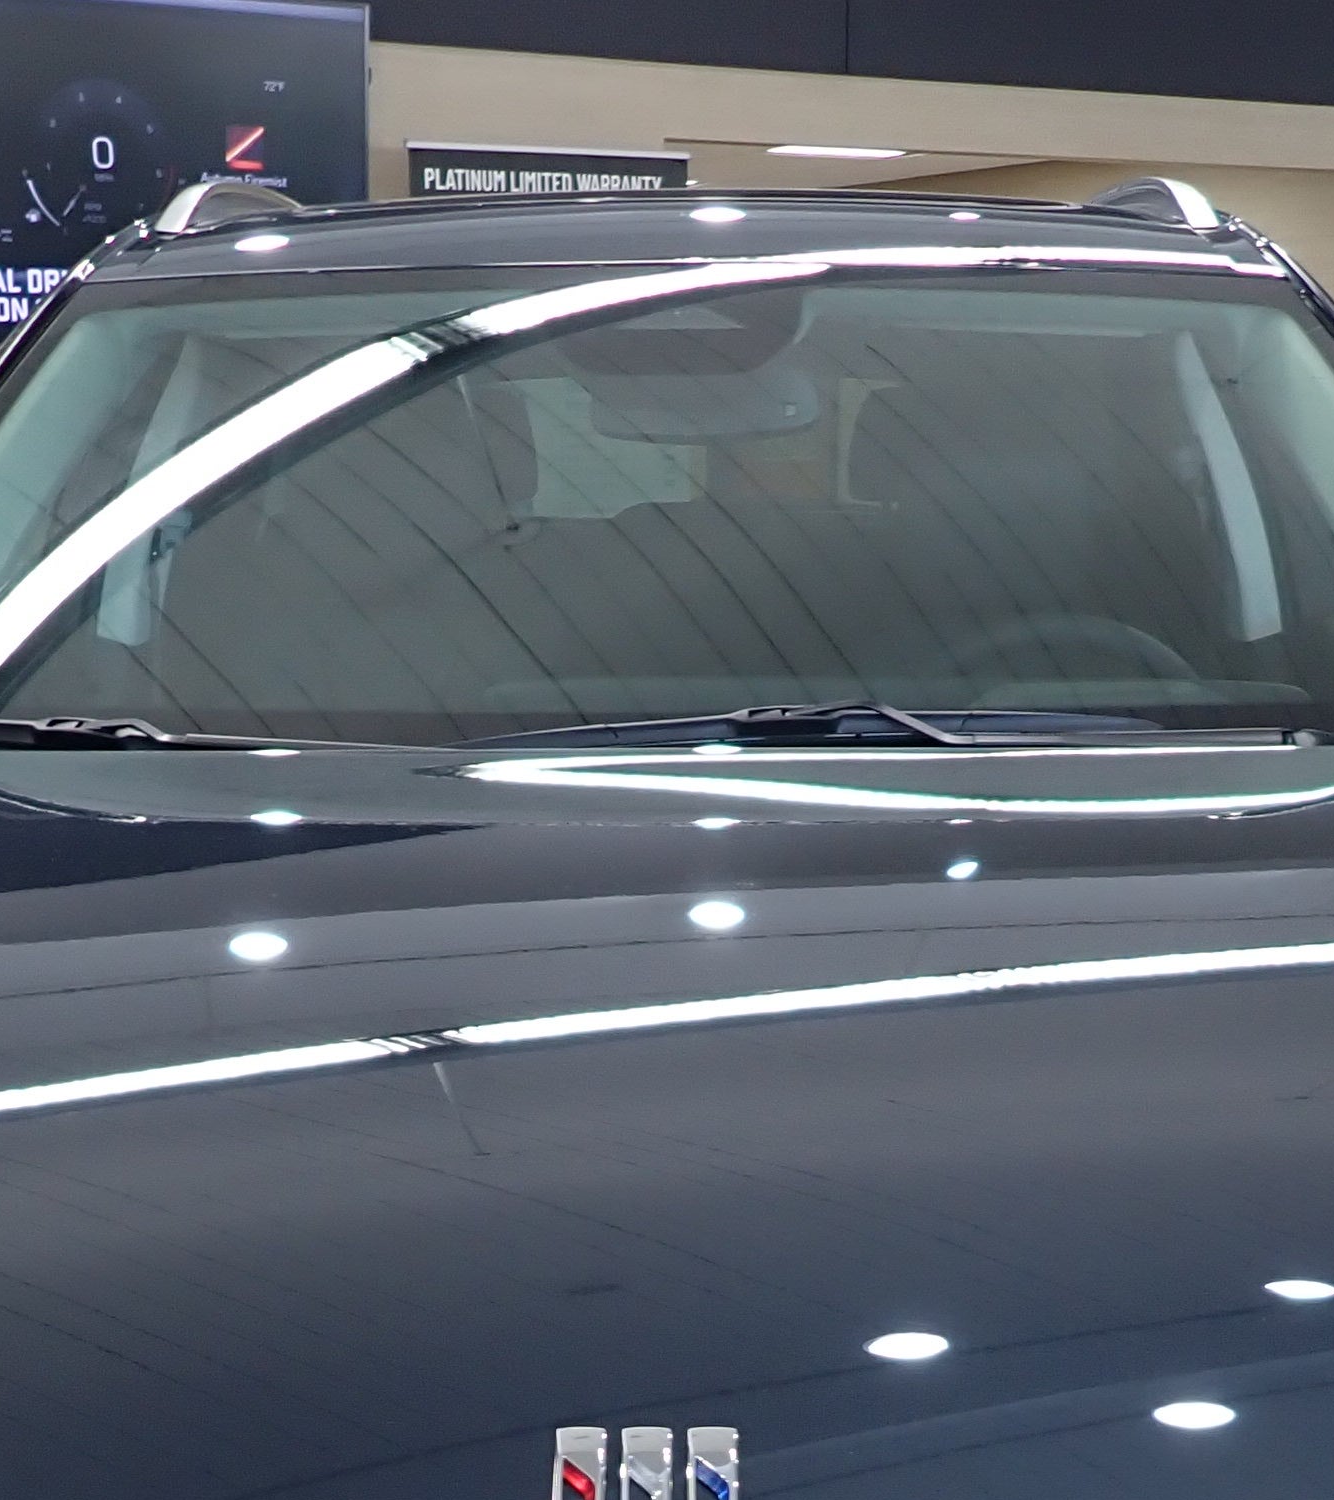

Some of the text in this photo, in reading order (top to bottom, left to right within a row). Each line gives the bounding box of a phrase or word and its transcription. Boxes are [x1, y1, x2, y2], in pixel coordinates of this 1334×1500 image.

[424, 167, 663, 192] PLATINUM LIMITED WARRANTY
[27, 268, 69, 294] DR
